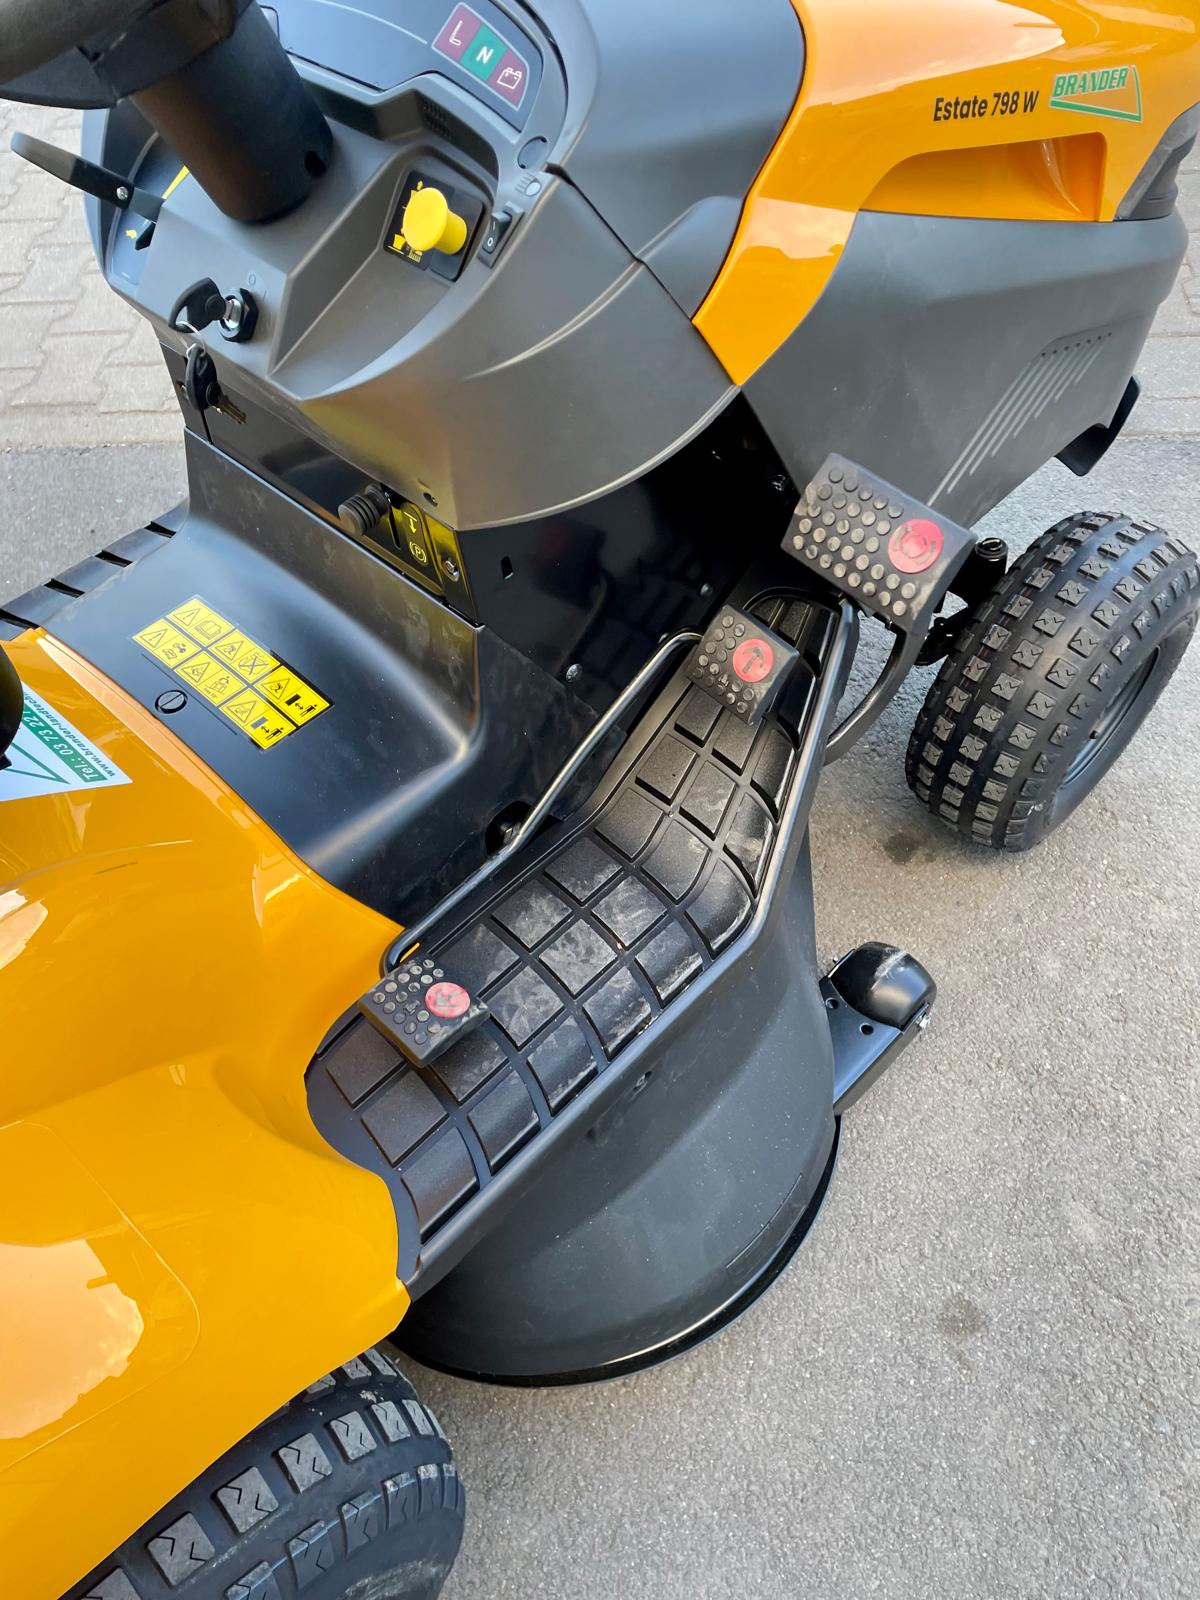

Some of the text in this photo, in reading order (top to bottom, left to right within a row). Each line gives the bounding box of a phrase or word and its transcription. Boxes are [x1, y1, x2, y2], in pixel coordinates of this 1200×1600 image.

[475, 46, 494, 64] N
[1053, 68, 1128, 97] BRANDER
[933, 91, 1039, 122] Estate 798 W
[23, 716, 99, 780] Tel.: 03 73 22
